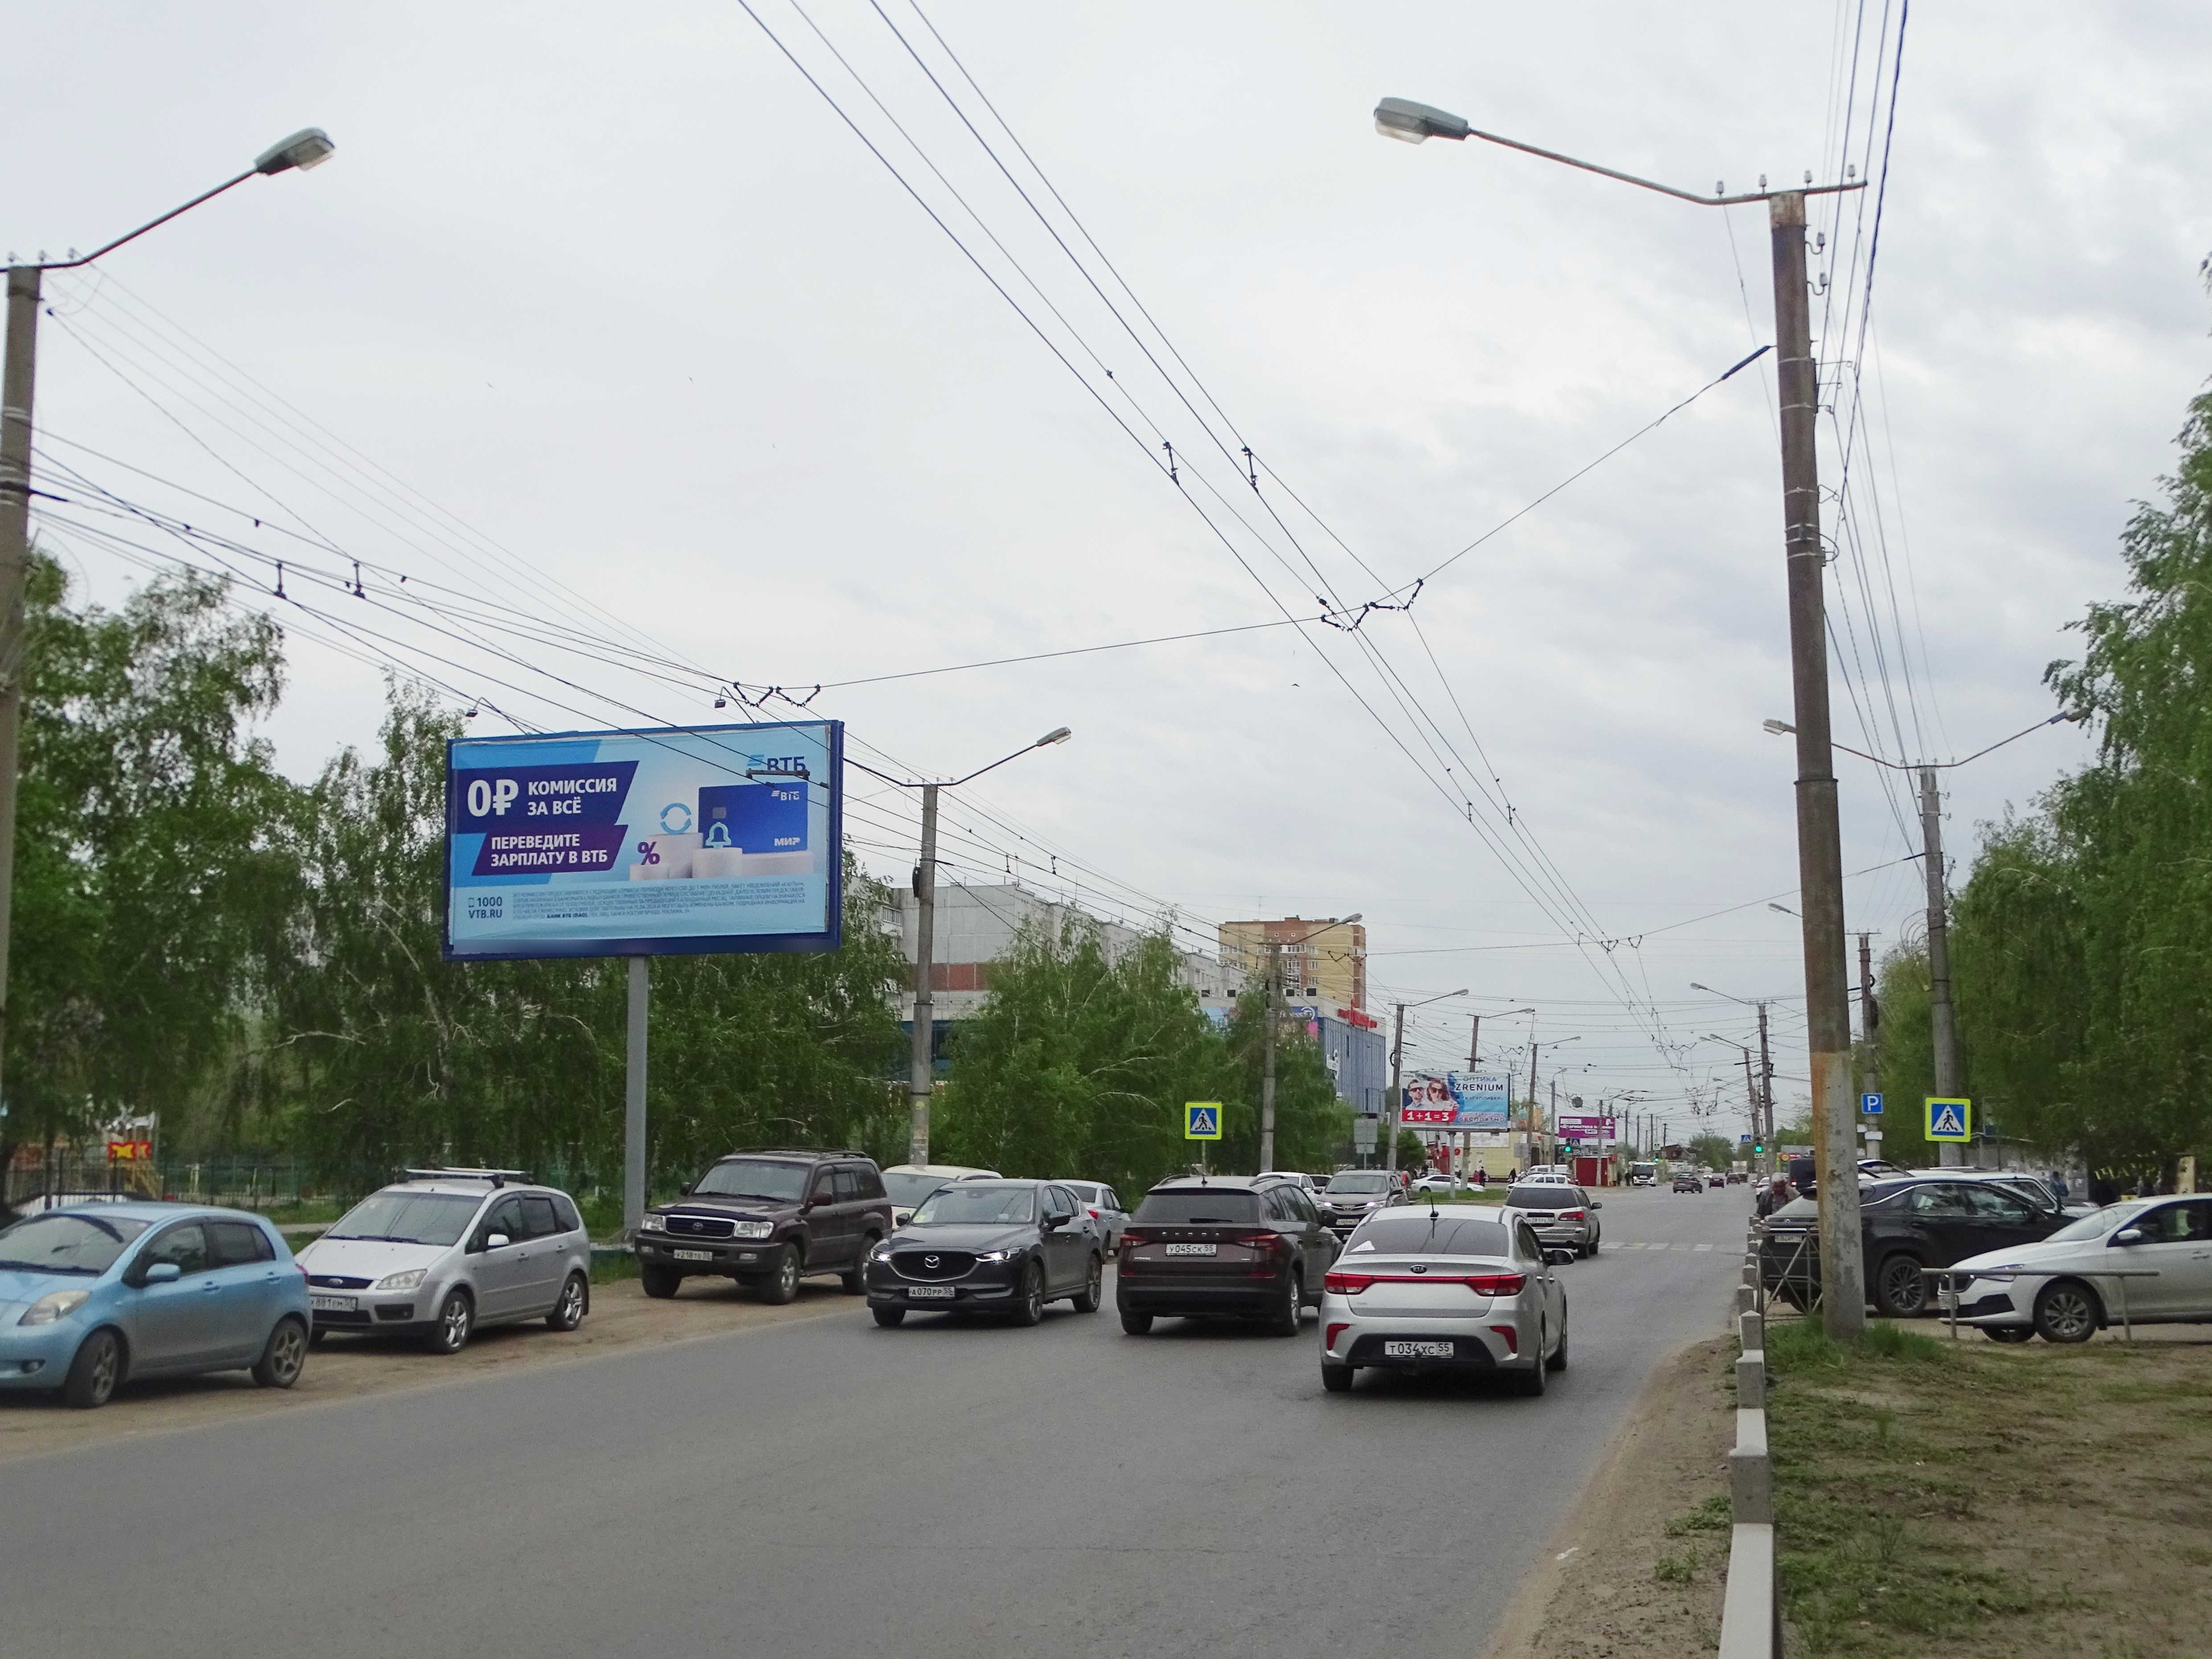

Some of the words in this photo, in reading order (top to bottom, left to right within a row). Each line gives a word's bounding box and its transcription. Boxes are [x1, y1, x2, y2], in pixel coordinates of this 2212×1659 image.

[767, 756, 806, 770] ВТБ
[528, 778, 617, 795] КОМИССИЯ
[780, 791, 800, 801] ВТБ
[528, 801, 548, 815] ЗА
[553, 797, 582, 815] ВСЁ
[491, 834, 580, 850] ПЕРЕВЕДИТЕ
[774, 837, 800, 846] МИР
[491, 851, 565, 867] ЗАРПЛАТУ
[568, 851, 578, 864] В
[581, 850, 607, 863] ВТБ
[477, 897, 502, 906] 1000
[468, 909, 502, 918] VTB.RU
[1456, 1083, 1503, 1091] ZRENIUM
